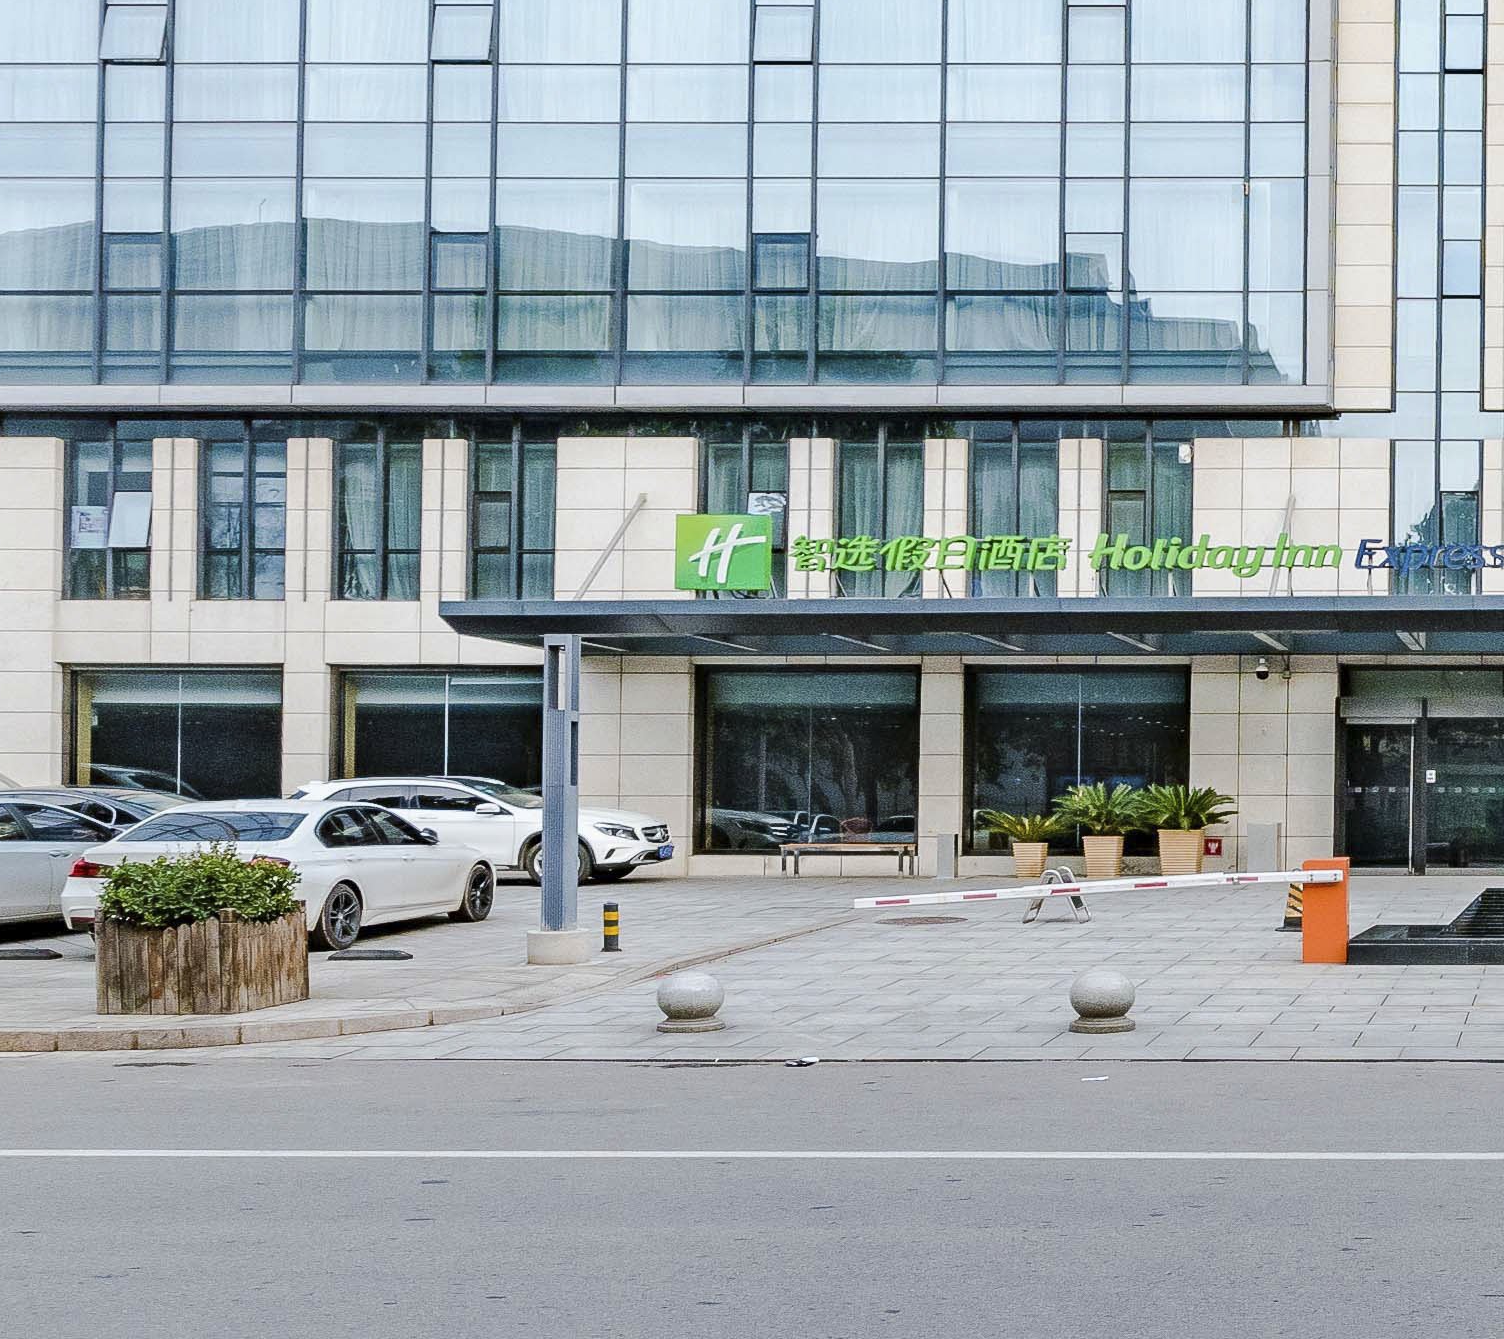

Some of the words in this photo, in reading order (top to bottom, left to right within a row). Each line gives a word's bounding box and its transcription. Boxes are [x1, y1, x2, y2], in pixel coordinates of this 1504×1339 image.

[789, 534, 1073, 573] 智选假日酒店
[1088, 532, 1269, 578] Holiday
[1271, 532, 1343, 569] Inn
